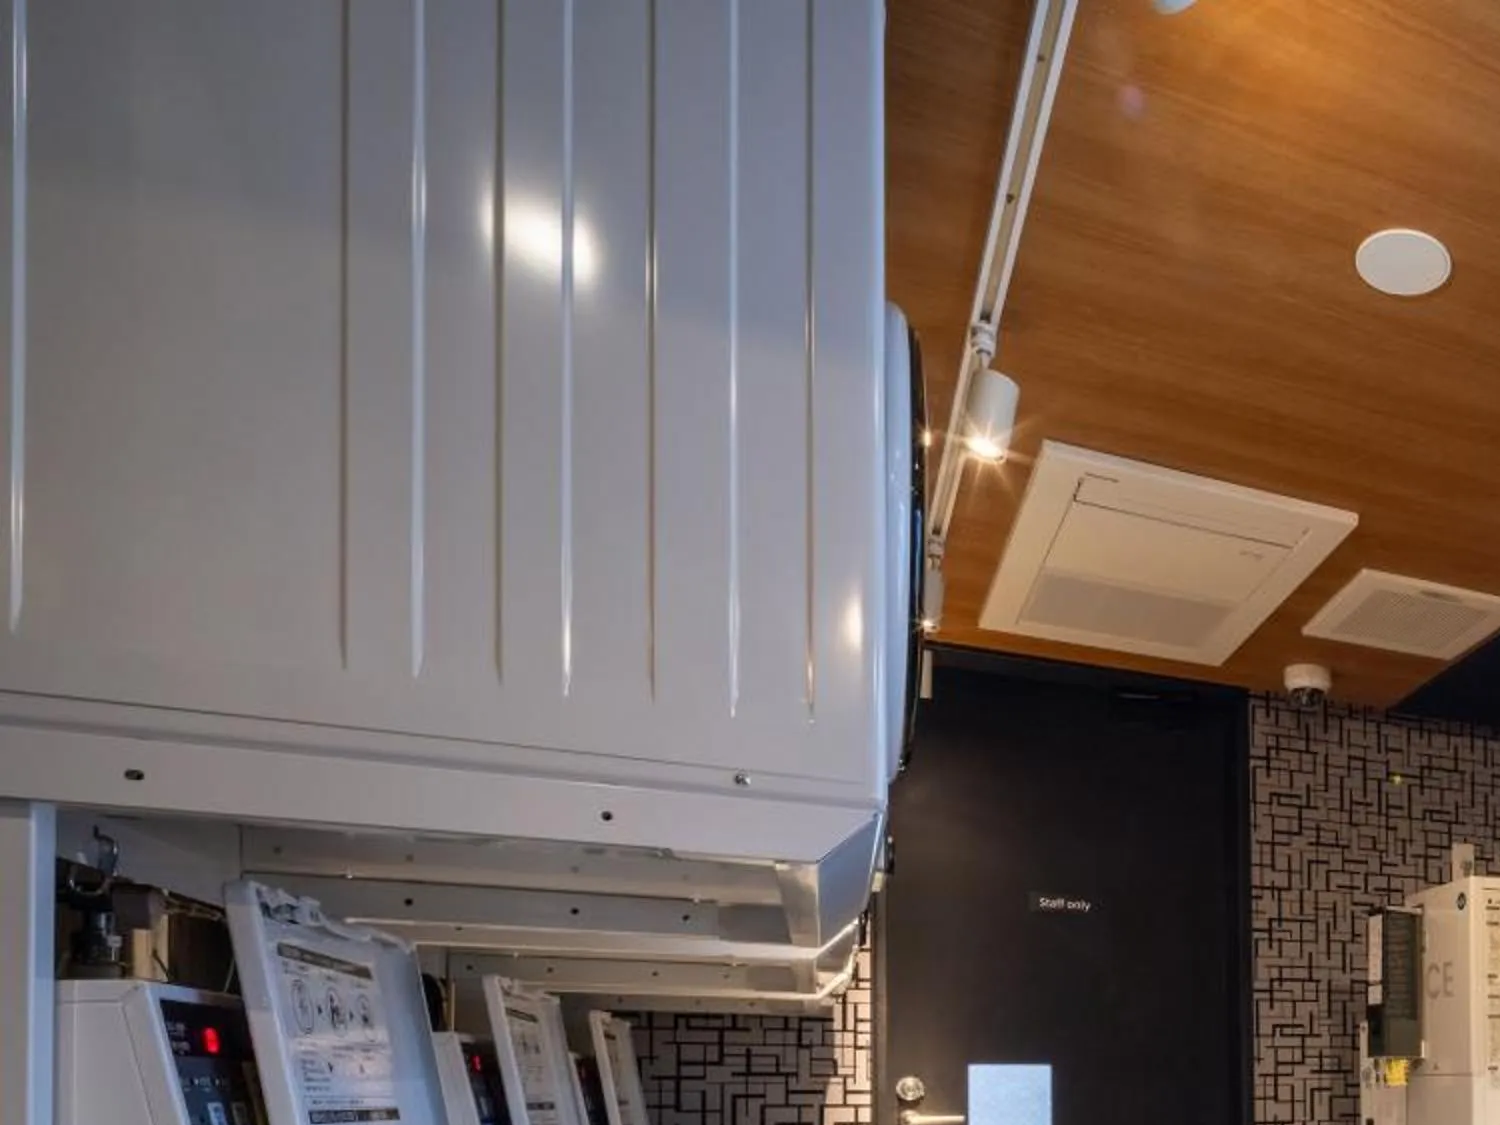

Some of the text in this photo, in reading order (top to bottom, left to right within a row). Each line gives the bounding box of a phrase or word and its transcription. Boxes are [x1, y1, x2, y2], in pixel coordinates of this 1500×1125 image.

[1039, 897, 1092, 913] Staff only
[1425, 960, 1454, 999] CE
